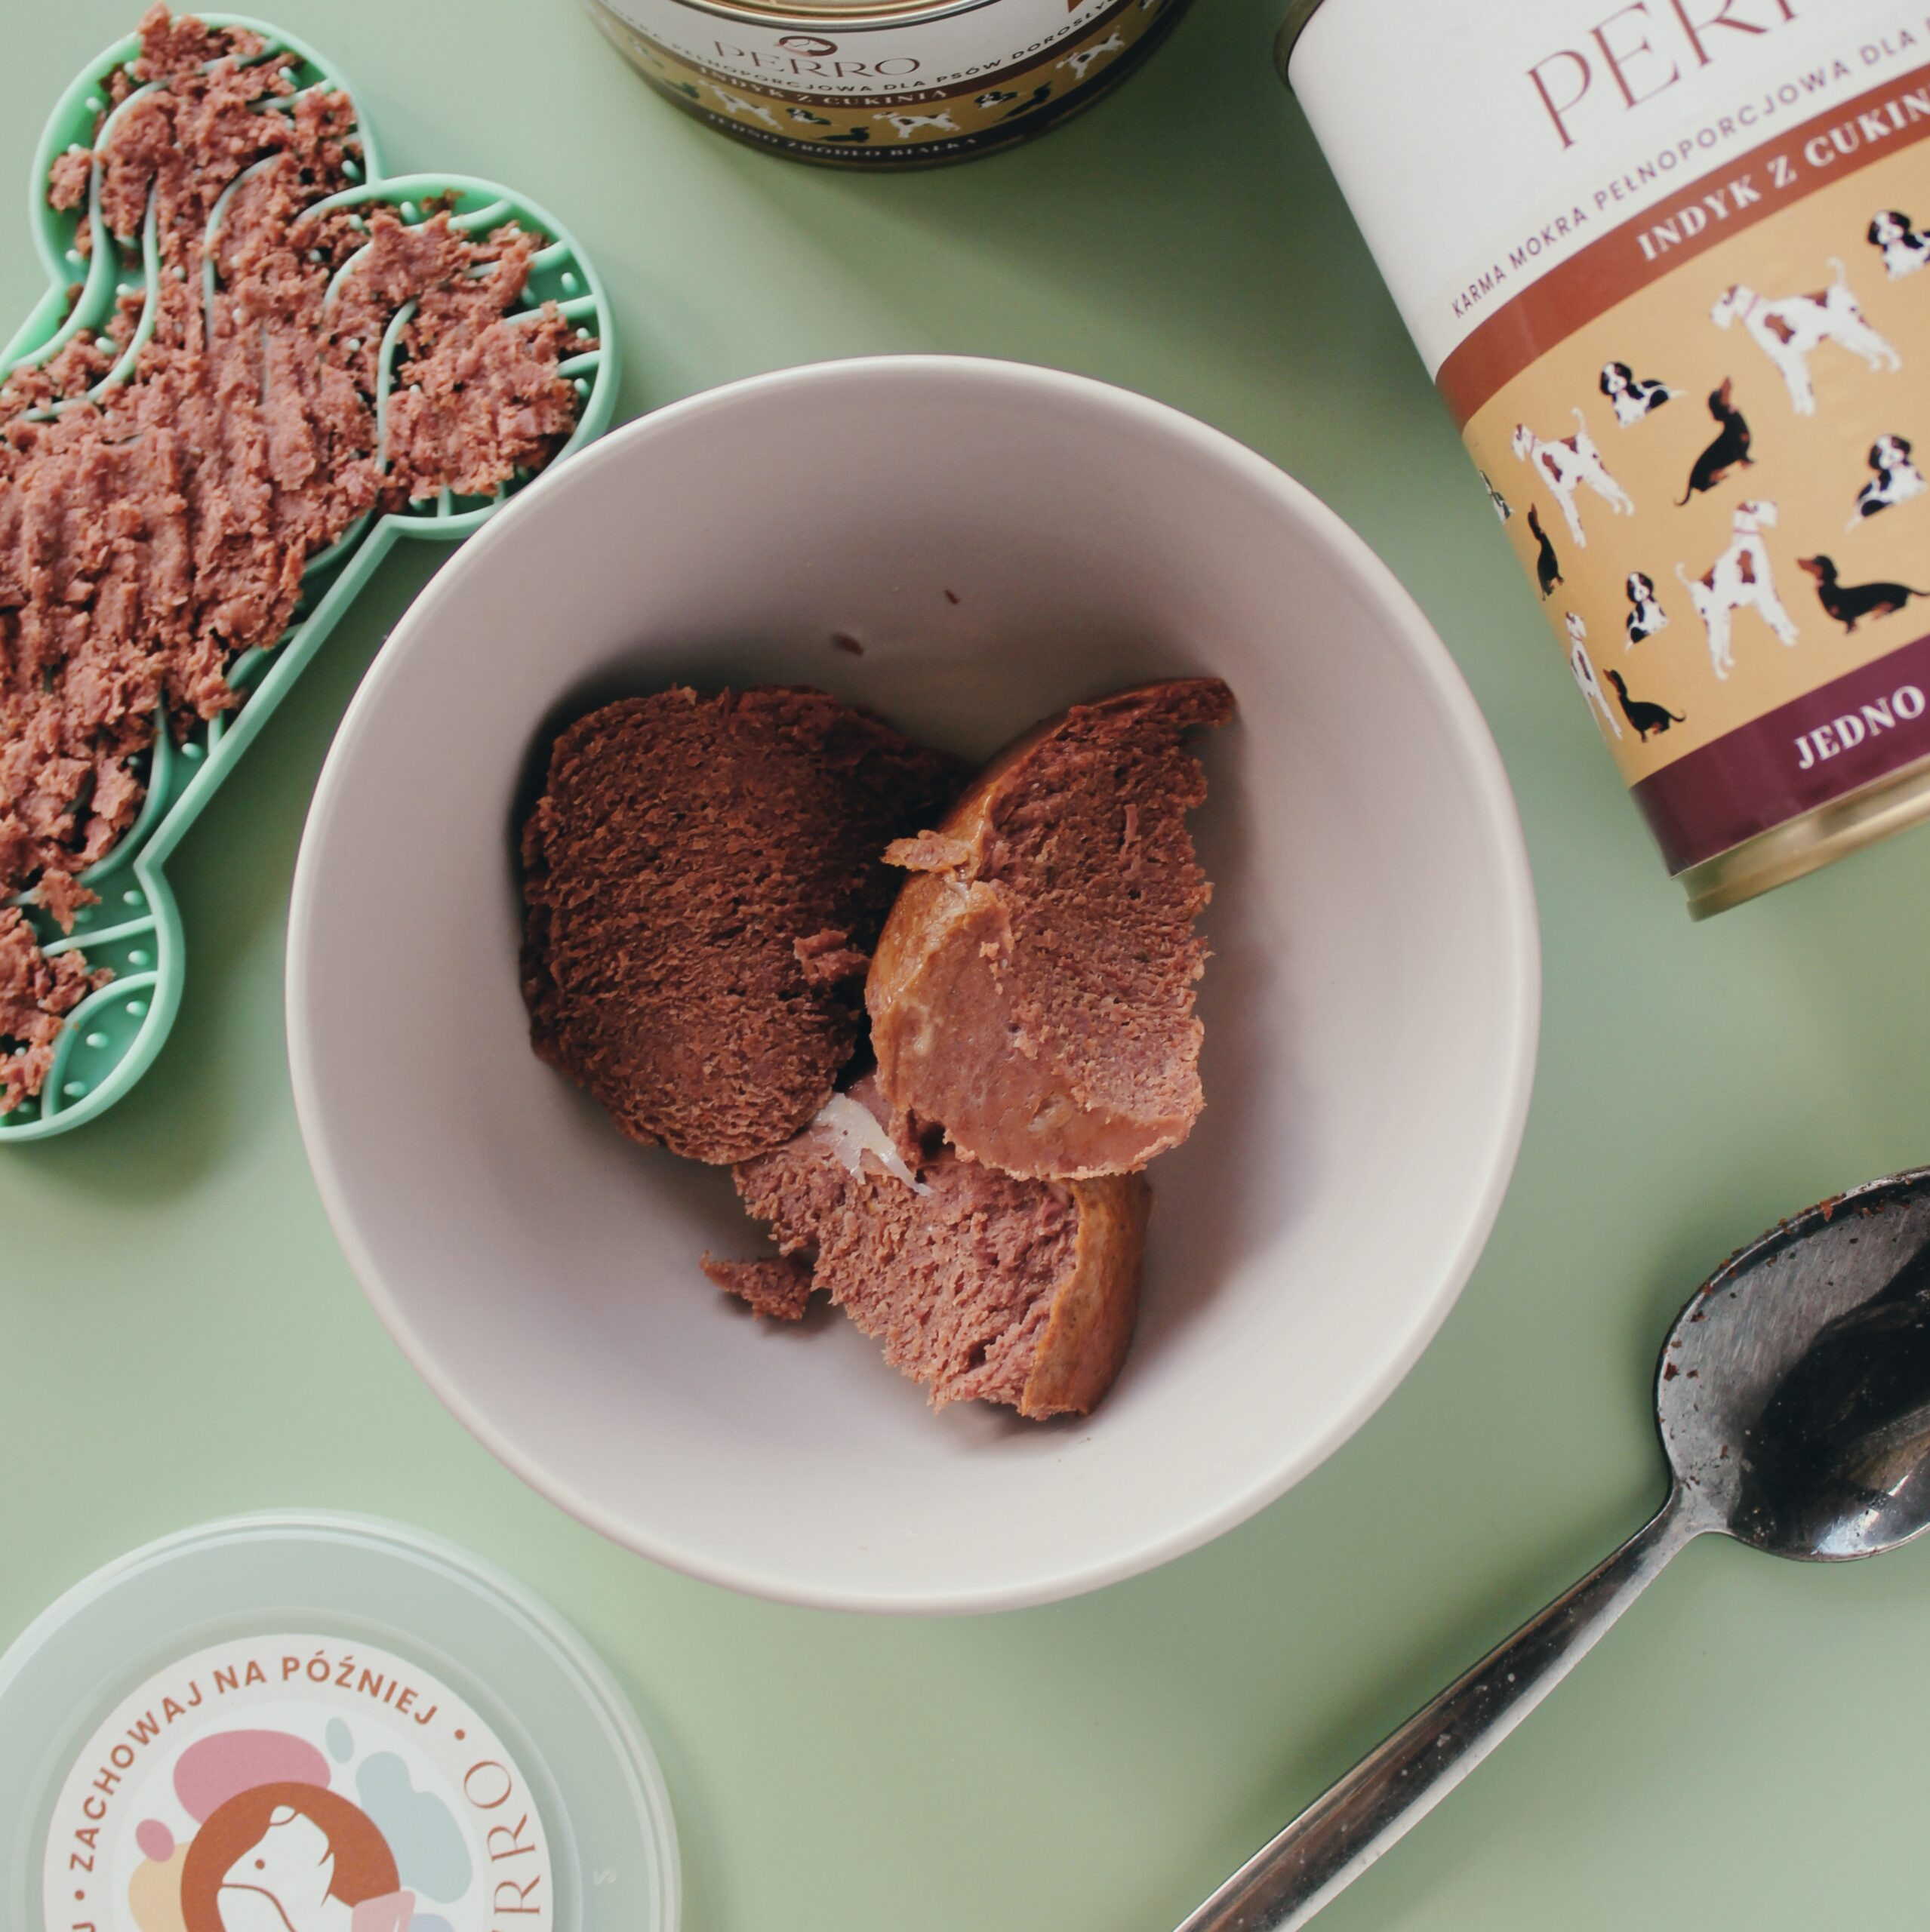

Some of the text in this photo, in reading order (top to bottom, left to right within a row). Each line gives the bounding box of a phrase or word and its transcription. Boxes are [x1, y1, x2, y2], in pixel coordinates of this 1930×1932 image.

[715, 40, 920, 78] PERRO
[884, 80, 925, 91] DLA
[937, 59, 1002, 82] PSÓW
[1011, 0, 1111, 60] DOROSŁY
[1525, 0, 1797, 151] PER
[1451, 29, 1916, 318] KARMA MOKRA PEŁNOPORCJOWA DLA
[1636, 174, 1760, 261] INDYK
[1766, 155, 1798, 189] Z
[1794, 685, 1925, 770] JEDNO
[70, 1650, 438, 1872] ZACHOWAJ NA PÓŹNIEJ
[463, 1760, 541, 1932] RRO
